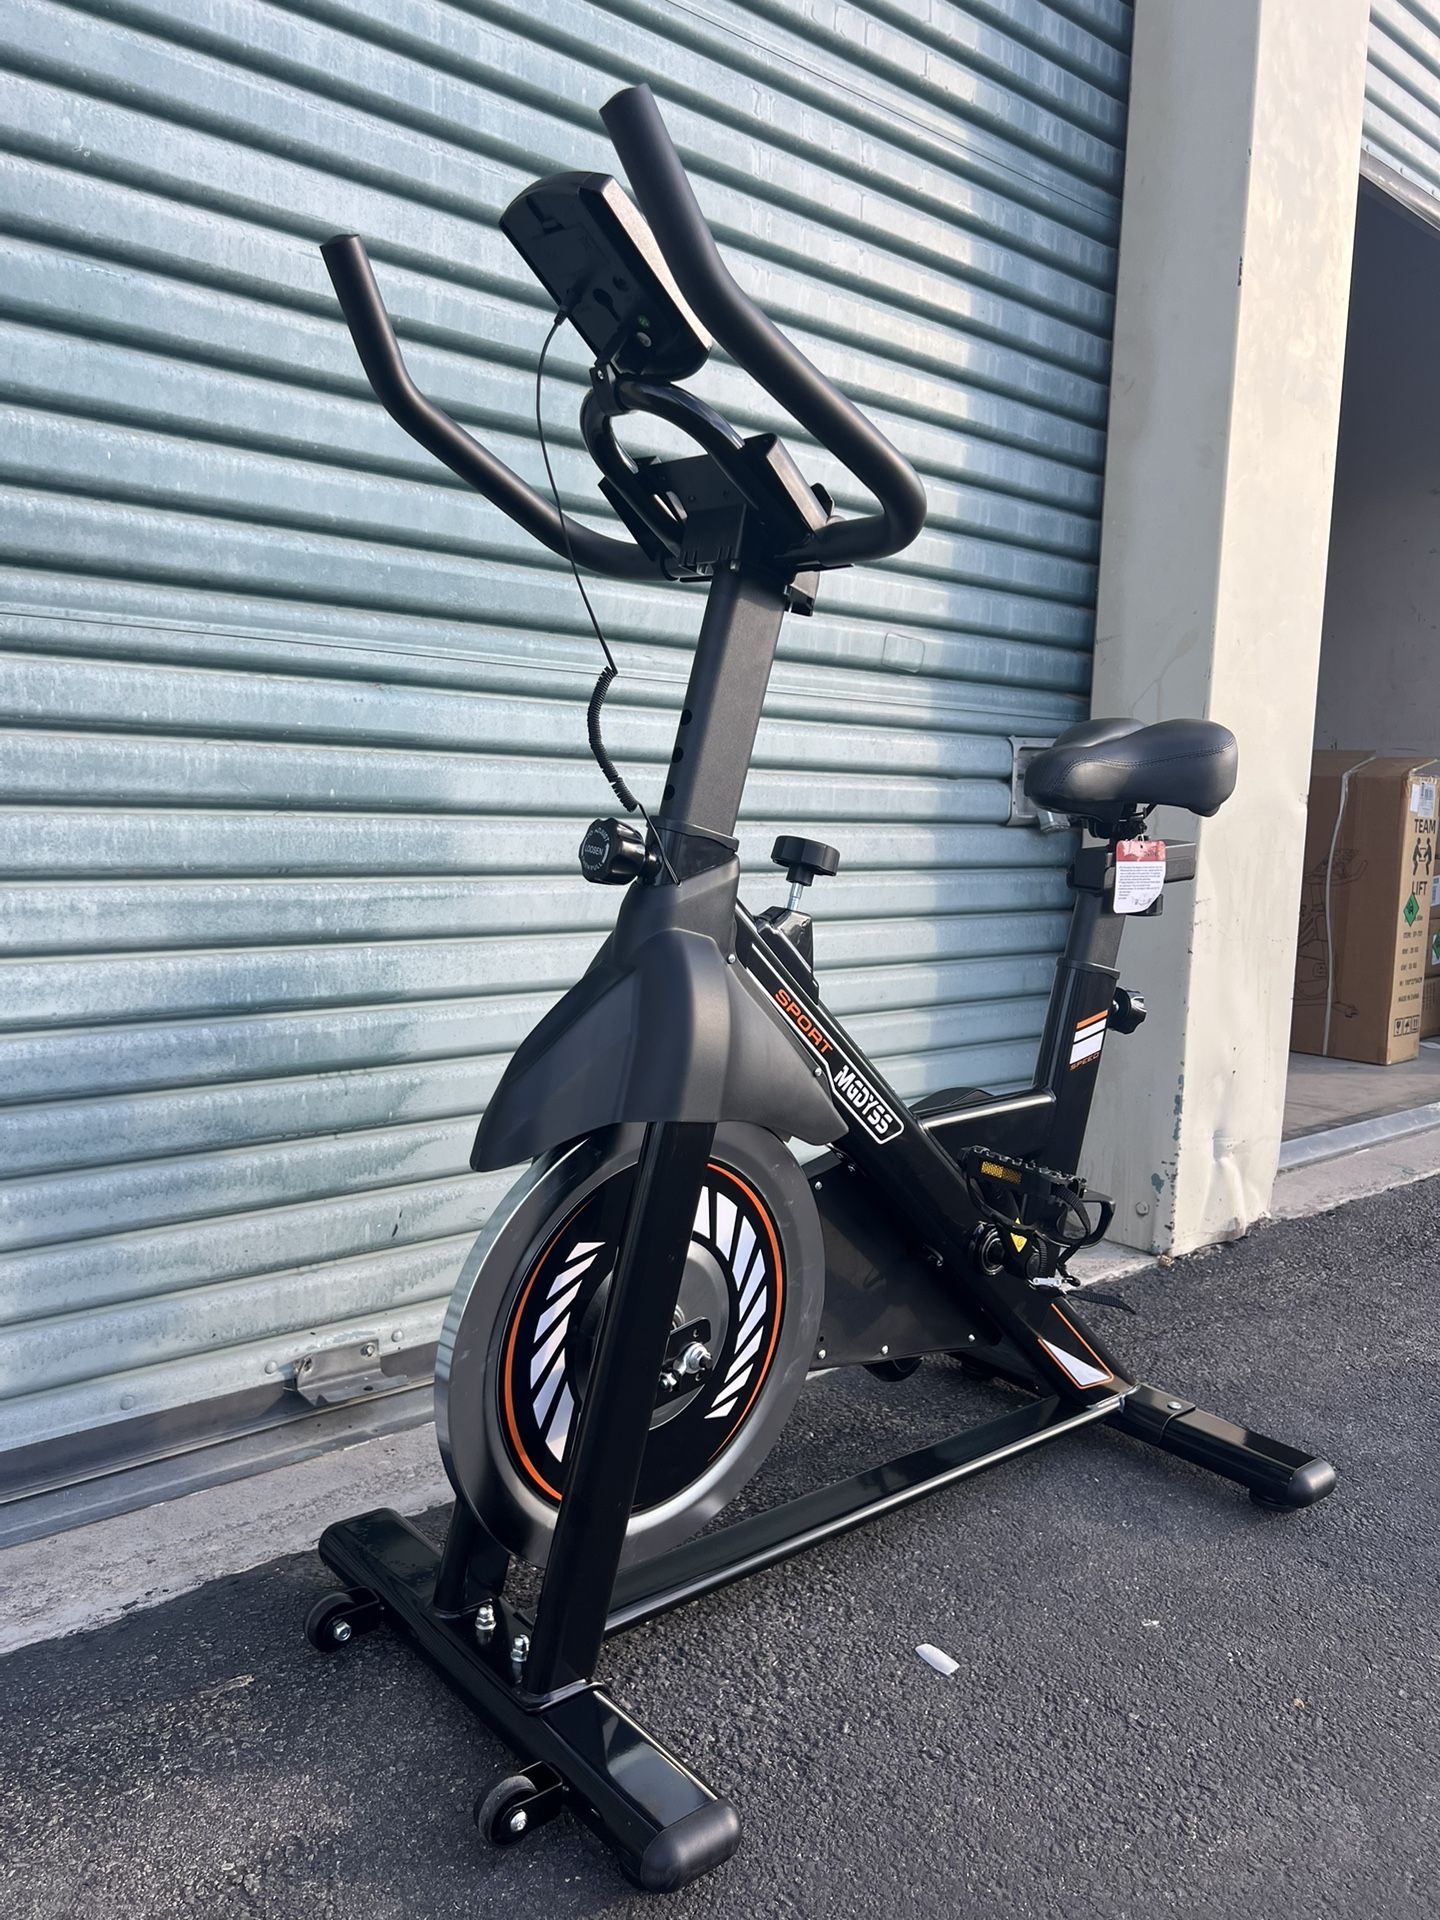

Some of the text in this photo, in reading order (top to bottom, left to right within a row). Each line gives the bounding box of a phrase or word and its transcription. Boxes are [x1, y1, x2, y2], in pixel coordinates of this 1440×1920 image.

[1414, 818, 1436, 834] TEAM
[585, 844, 603, 856] LOOSEN
[1411, 881, 1428, 896] LIFT
[774, 988, 834, 1054] SPORT
[1070, 1052, 1100, 1071] SPEED
[834, 1065, 894, 1135] MGDYSS
